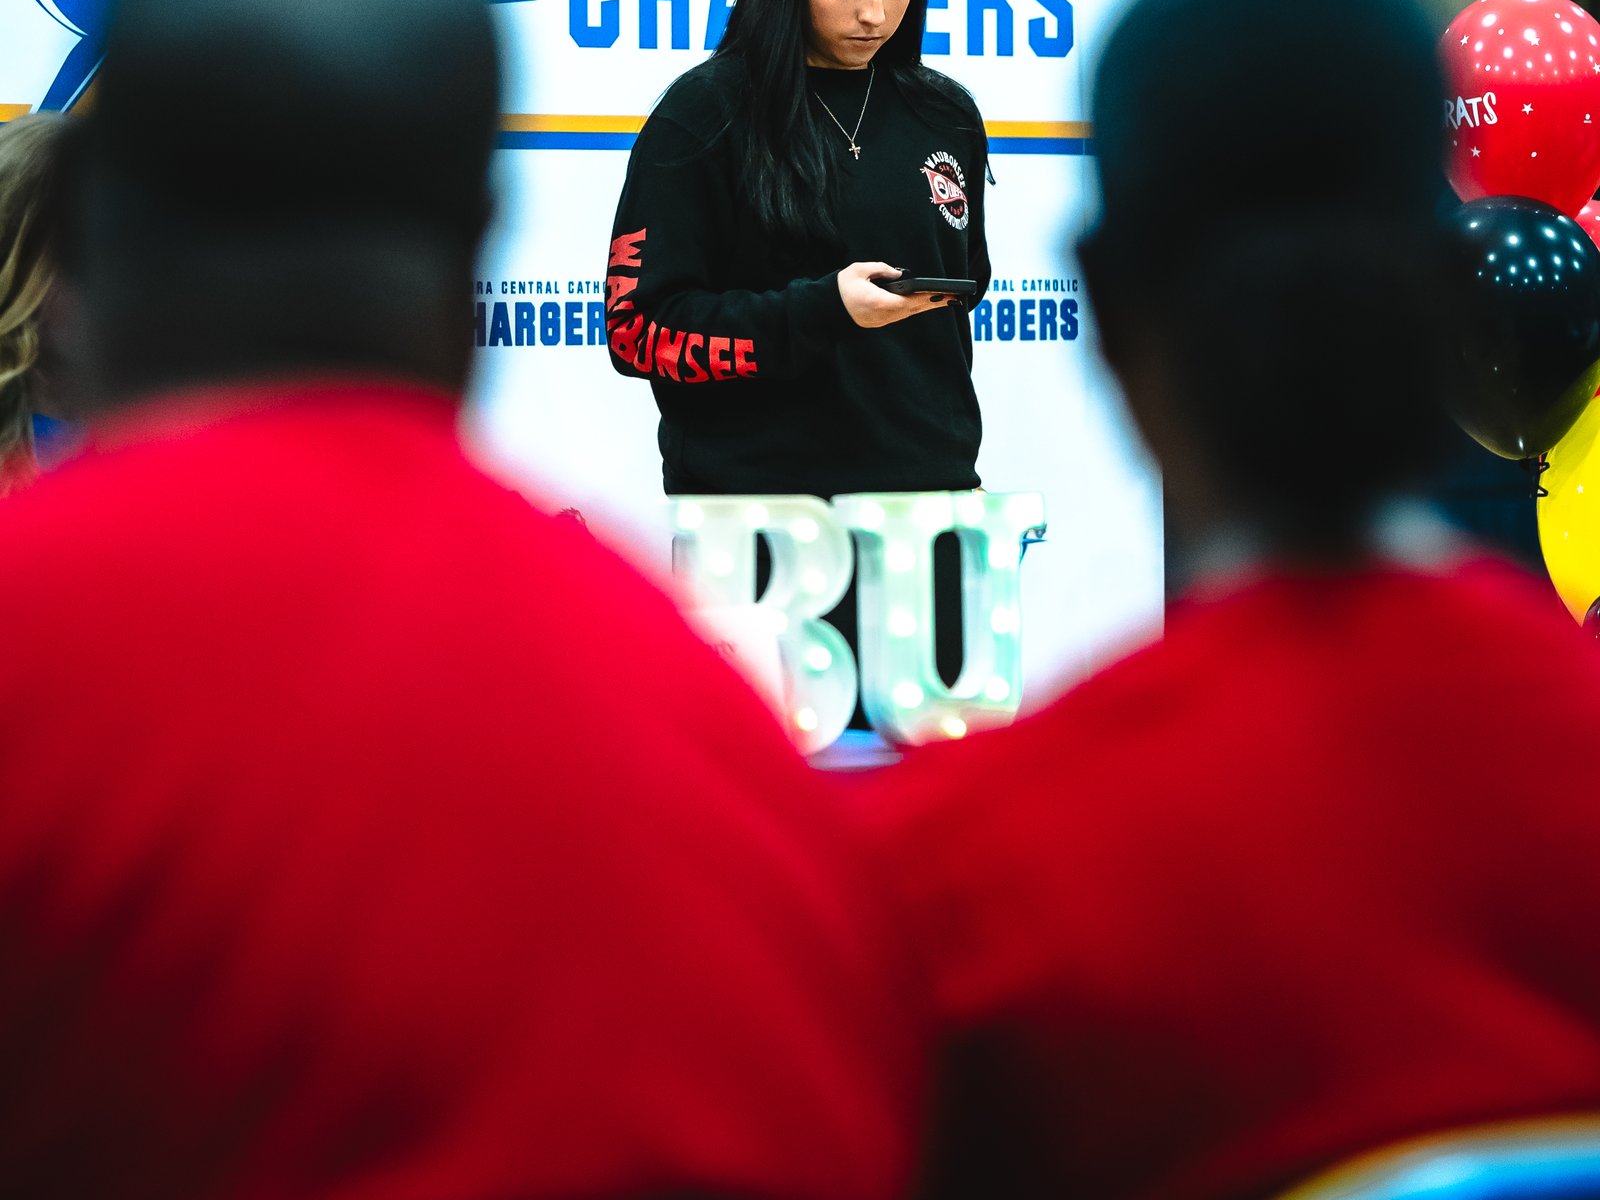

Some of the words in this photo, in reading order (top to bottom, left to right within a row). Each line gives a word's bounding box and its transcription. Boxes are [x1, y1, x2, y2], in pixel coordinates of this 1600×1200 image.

[1444, 91, 1498, 130] RATS
[924, 150, 966, 189] WAUBONSEE
[500, 280, 560, 295] CENTRAL
[567, 280, 606, 295] CATH
[1021, 278, 1079, 292] CATHOLIC
[470, 301, 607, 347] HARGER
[606, 227, 758, 384] WAUBONSEE
[973, 298, 1079, 342] RGERS
